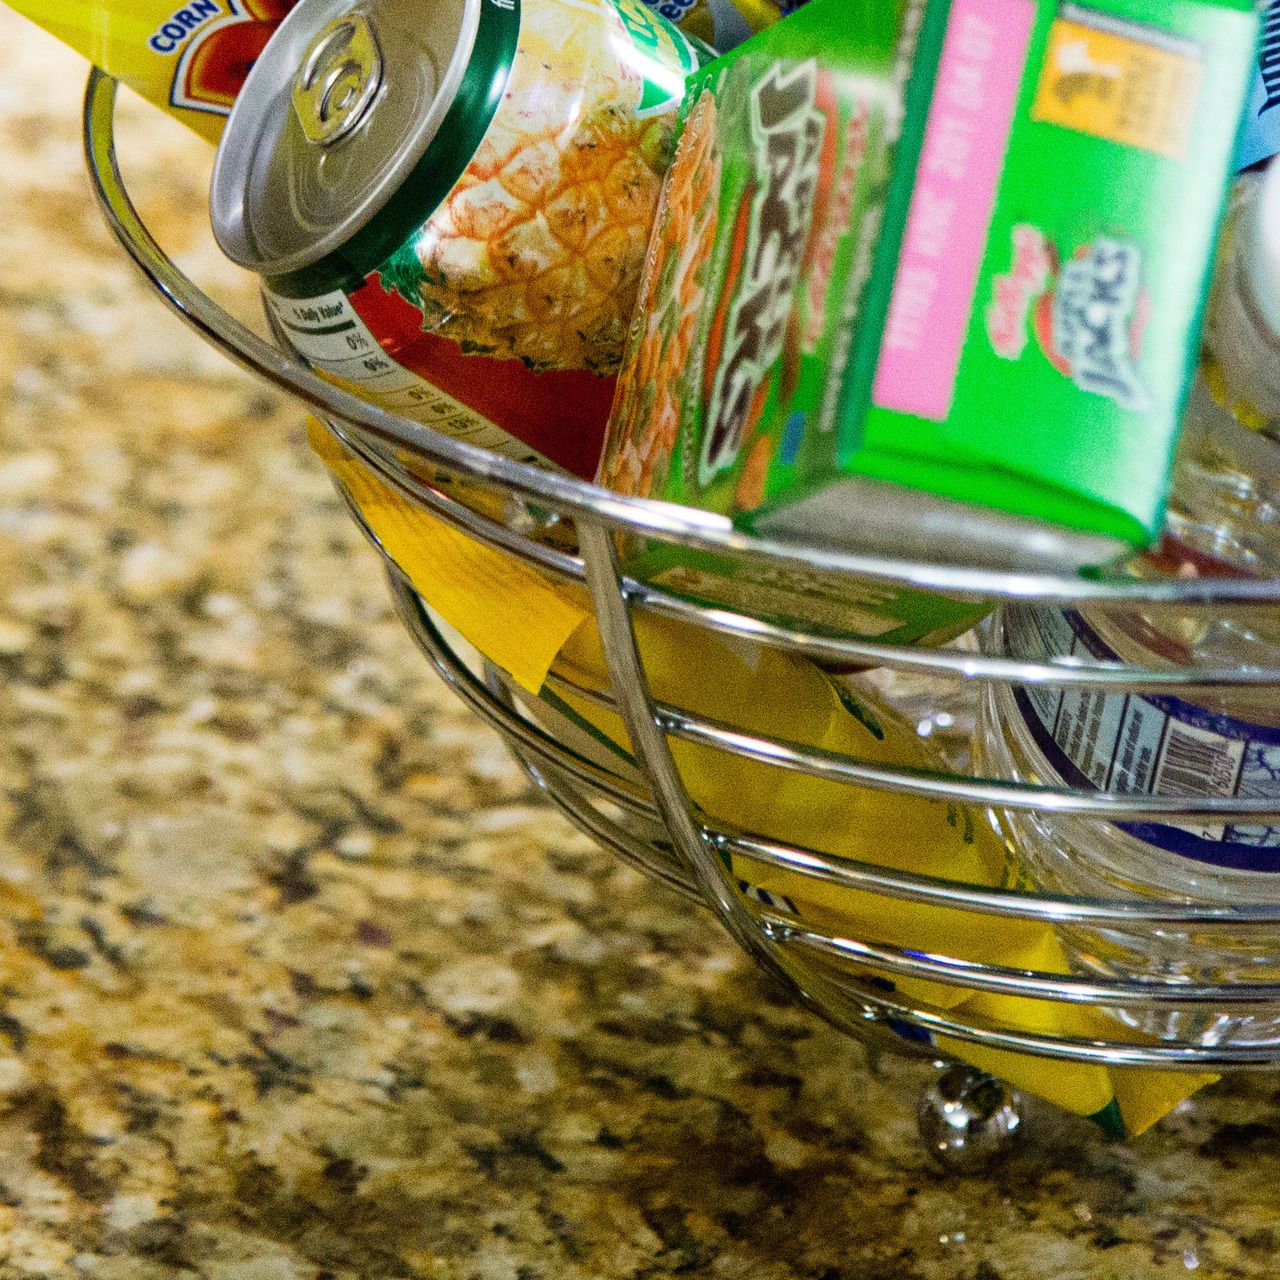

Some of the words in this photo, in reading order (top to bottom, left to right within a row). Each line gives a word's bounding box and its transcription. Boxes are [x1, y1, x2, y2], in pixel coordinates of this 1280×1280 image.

[346, 331, 369, 352] 0%
[701, 60, 824, 486] JACKS
[1070, 240, 1148, 408] JACKS
